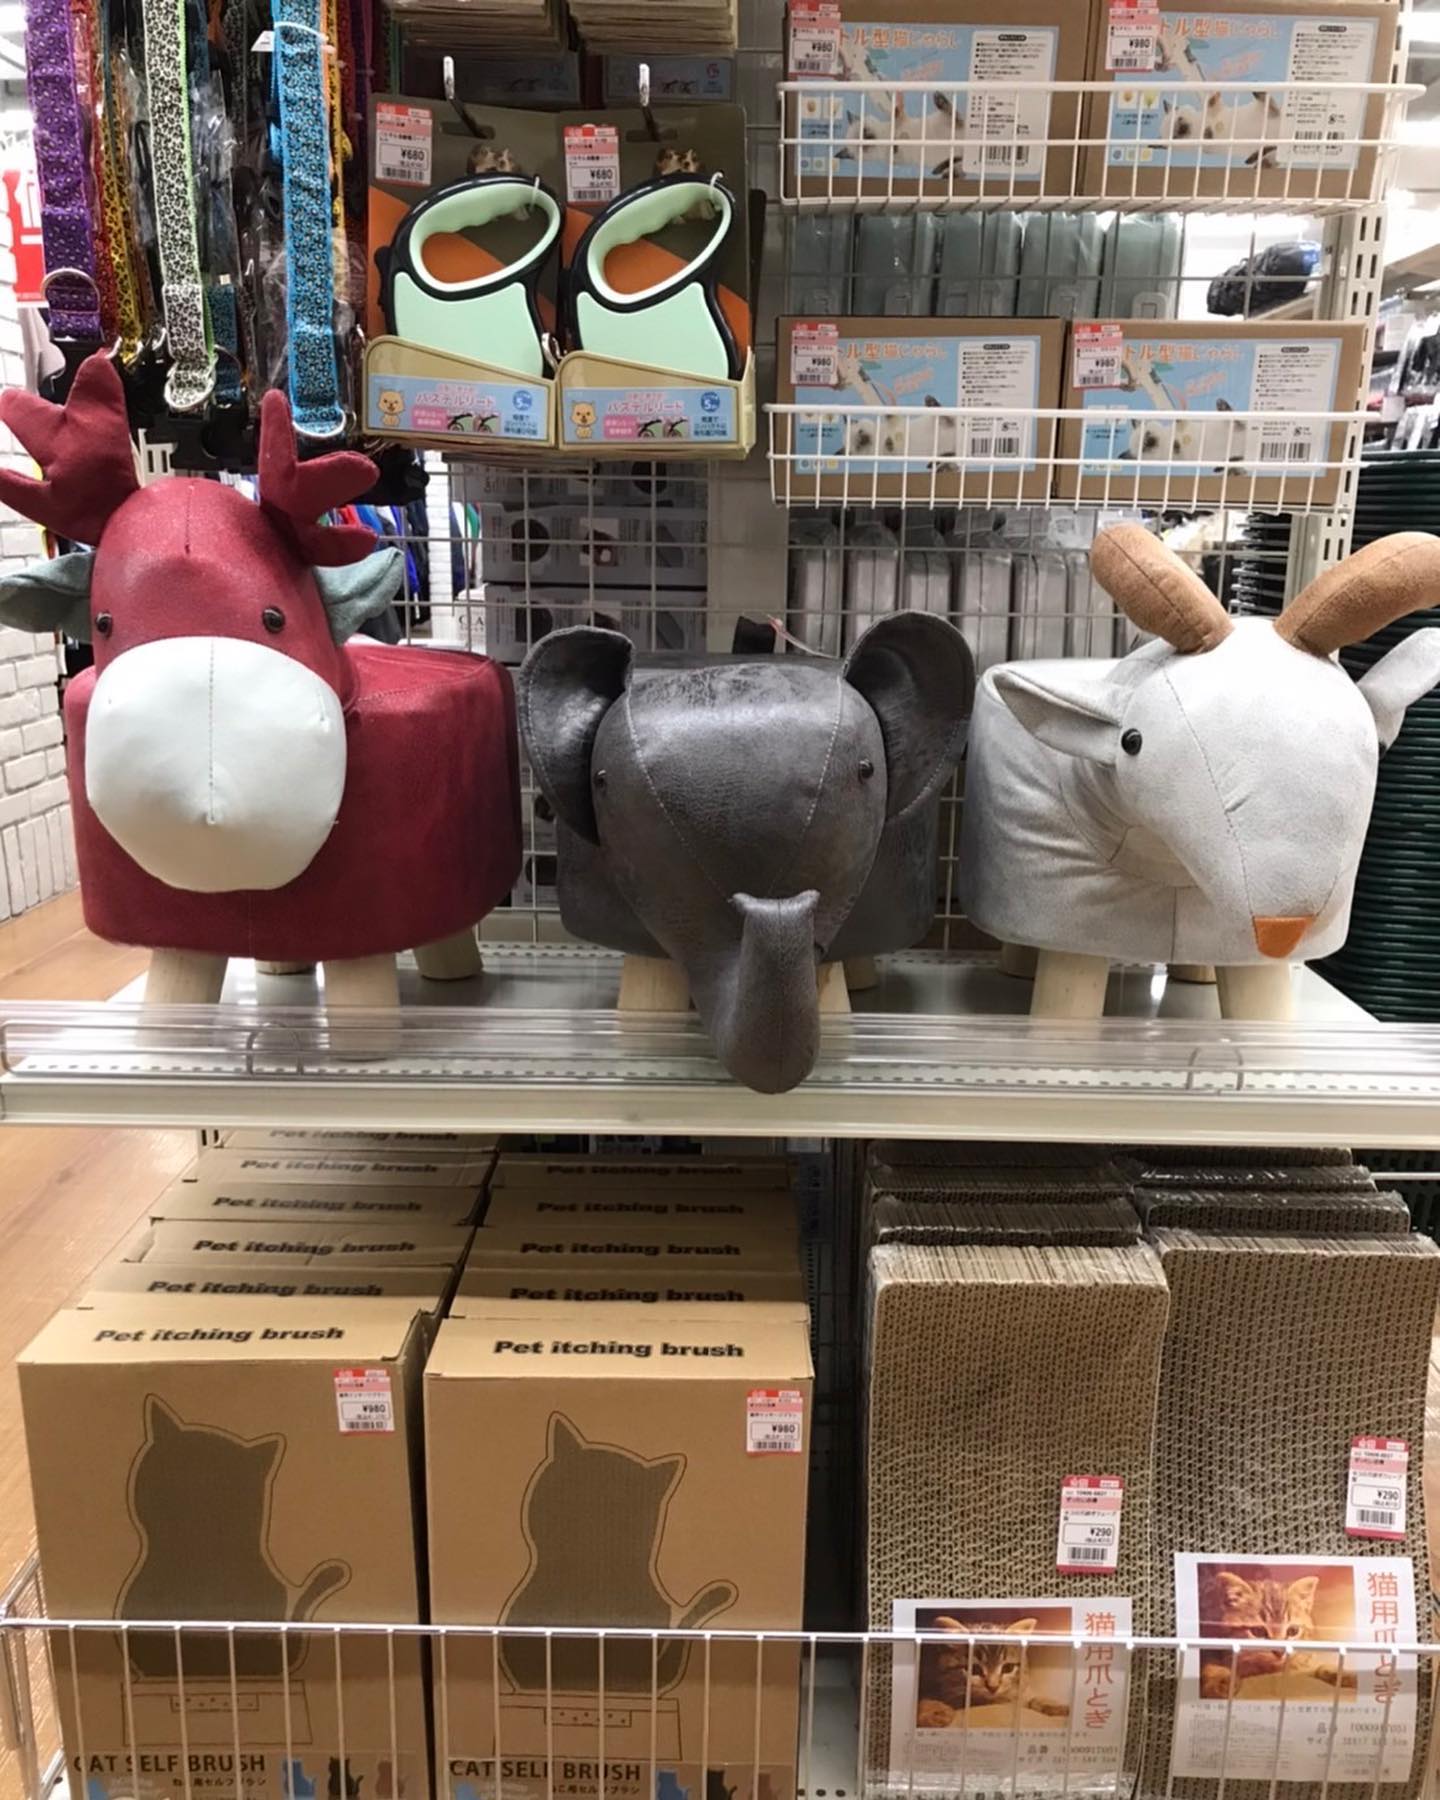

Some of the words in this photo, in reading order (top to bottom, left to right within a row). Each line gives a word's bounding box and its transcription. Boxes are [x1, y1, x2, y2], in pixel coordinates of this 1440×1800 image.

[1129, 39, 1150, 48] ¥980
[401, 148, 425, 161] ¥680
[590, 169, 613, 179] ¥680
[812, 358, 832, 366] ¥980
[1095, 359, 1116, 368] ¥980
[241, 1160, 278, 1170] Pet
[286, 1160, 366, 1173] itching
[372, 1163, 438, 1173] brush
[213, 1197, 254, 1207] Pet
[260, 1198, 345, 1211] itching
[351, 1201, 422, 1211] brush
[537, 1202, 577, 1212] Pet
[584, 1203, 668, 1214] itching
[675, 1204, 744, 1214] brush
[193, 1240, 239, 1251] Pet
[245, 1241, 333, 1256] itching
[341, 1242, 415, 1253] brush
[520, 1243, 564, 1253] Pet
[571, 1243, 661, 1256] itching
[667, 1244, 741, 1255] brush
[147, 1280, 196, 1294] Pet
[201, 1281, 297, 1297] itching
[302, 1283, 383, 1296] brush
[510, 1288, 557, 1300] Pet
[564, 1288, 659, 1303] itching
[666, 1289, 744, 1302] brush
[95, 1329, 146, 1342] Pet
[151, 1328, 254, 1343] itching
[260, 1327, 345, 1341] brush
[494, 1340, 544, 1354] Pet
[551, 1341, 652, 1357] itching
[660, 1342, 744, 1357] brush
[362, 1404, 386, 1413] ¥980
[772, 1424, 795, 1433] ¥980
[1377, 1490, 1399, 1500] ¥290
[1090, 1528, 1112, 1537] ¥290
[188, 1755, 265, 1773] BRUSH
[450, 1760, 496, 1778] CAT
[563, 1762, 640, 1781] BRUSH
